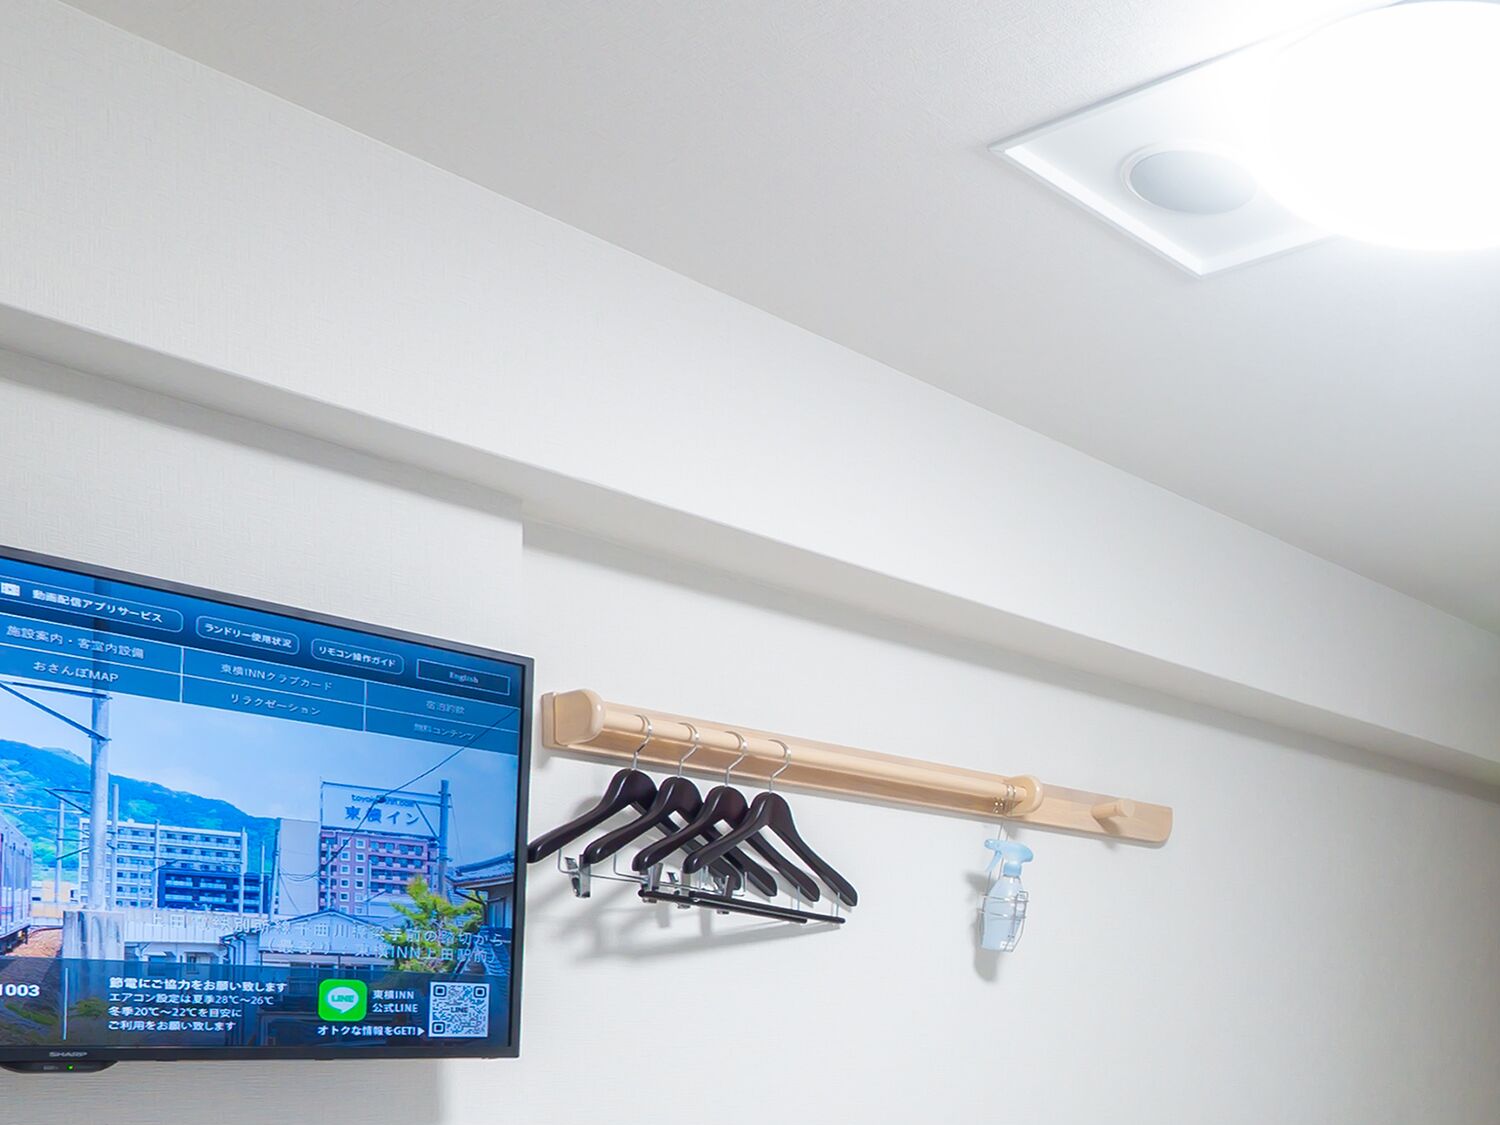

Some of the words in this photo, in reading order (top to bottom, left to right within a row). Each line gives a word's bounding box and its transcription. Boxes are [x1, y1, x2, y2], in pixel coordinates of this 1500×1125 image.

[32, 589, 163, 623] 動画配信アプリサービス
[6, 625, 145, 659] 施設案内・客室内設備
[204, 623, 292, 648] ランドリー使用状況
[319, 646, 396, 668] リモコン操作ガイド
[33, 661, 119, 683] おさんぽMAP
[221, 663, 333, 690] 東横INNクラブカード
[449, 671, 479, 684] English
[231, 694, 321, 715] リラクゼーション
[109, 977, 288, 992] 節電にご協力をお願い致します
[373, 989, 415, 1000] 東横INN
[331, 994, 354, 1003] LINE
[372, 1003, 419, 1013] 公式LINE
[108, 1020, 237, 1032] ご利用をお願い致します
